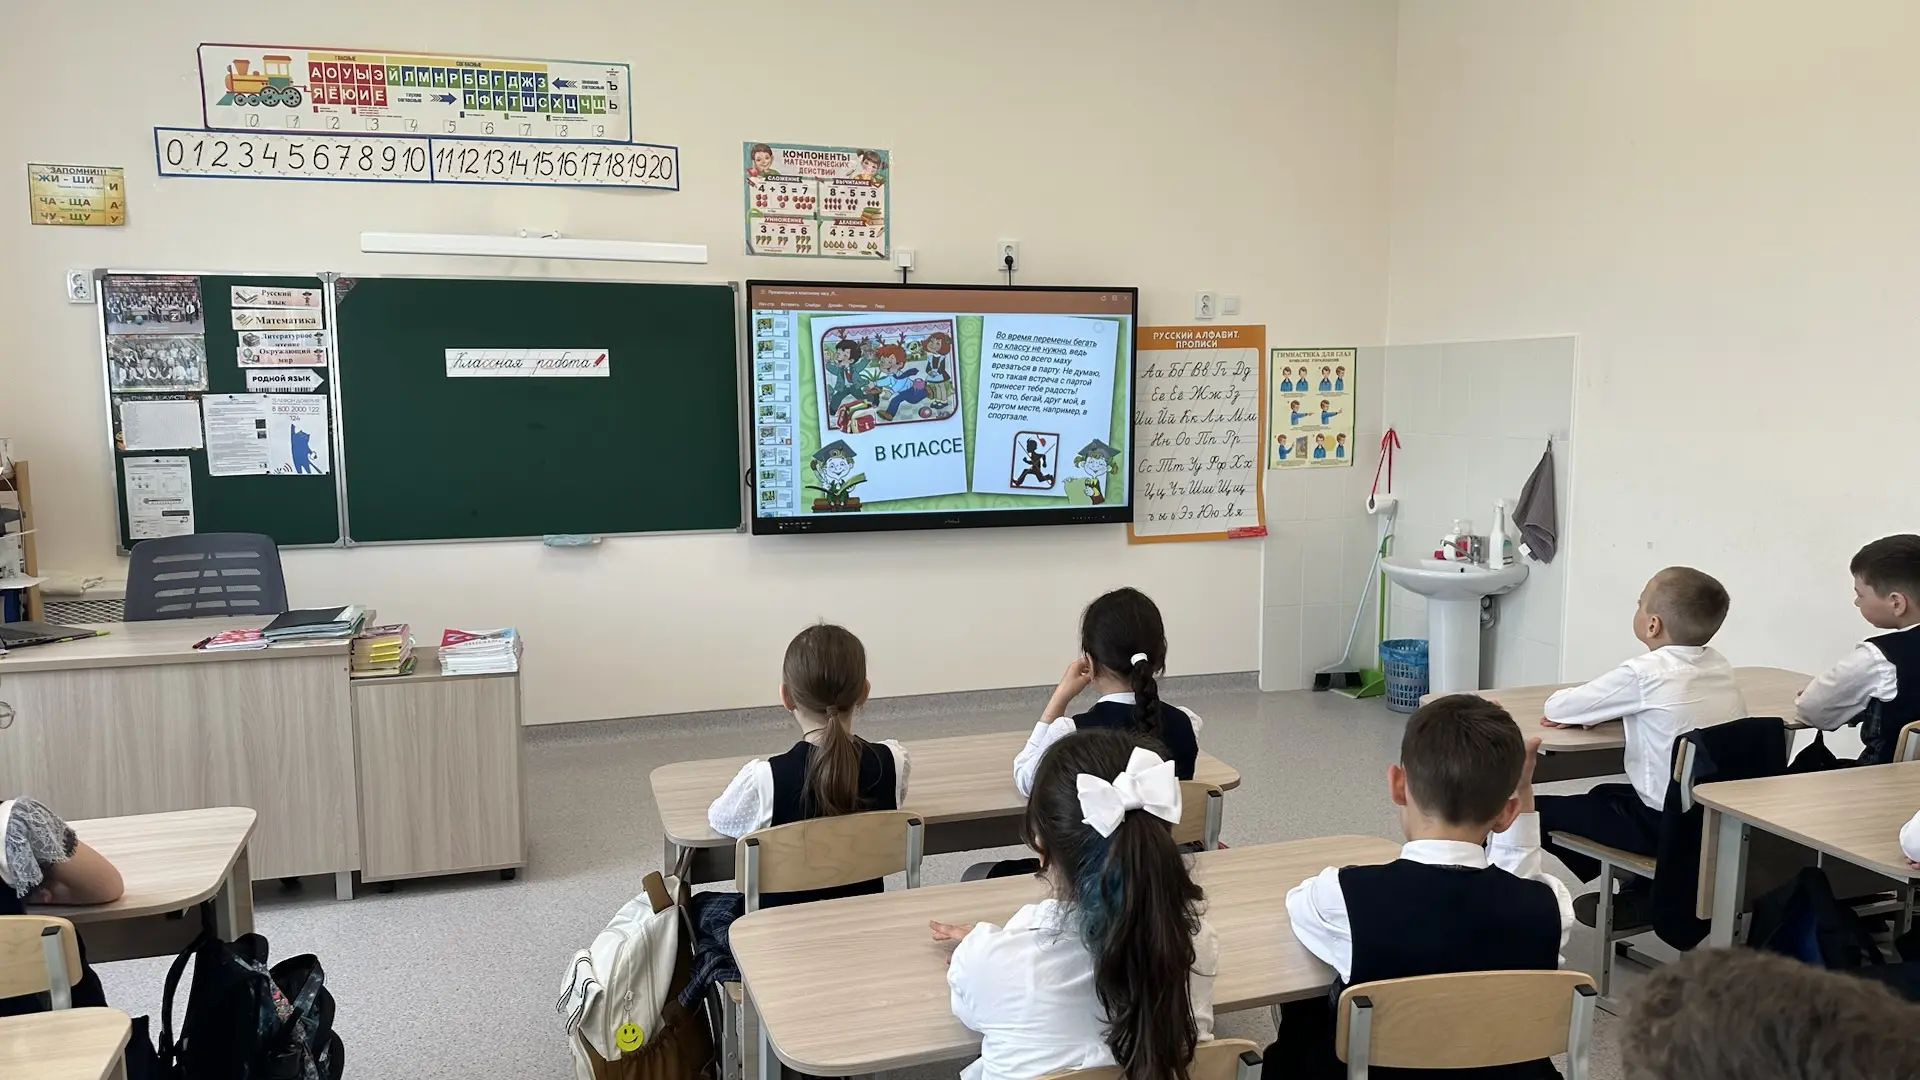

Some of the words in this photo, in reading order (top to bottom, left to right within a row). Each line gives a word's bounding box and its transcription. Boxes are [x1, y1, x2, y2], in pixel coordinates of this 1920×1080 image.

[167, 139, 183, 165] 0
[194, 140, 203, 166] 1
[212, 141, 228, 167] 2
[238, 142, 253, 168] 3
[262, 143, 277, 168] 4
[288, 144, 304, 169] 5
[313, 144, 329, 170] 6
[336, 145, 351, 170] 7
[358, 146, 373, 171] 8
[381, 146, 396, 172] 9
[402, 147, 426, 172] 10
[782, 150, 850, 161] КОМПОНЕНТЫ
[436, 148, 453, 173] 11
[458, 149, 479, 173] 12
[484, 149, 504, 174] 13
[508, 150, 528, 175] 14
[533, 151, 553, 176] 15
[557, 152, 578, 176] 16
[581, 152, 602, 176] 17
[605, 153, 624, 177] 18
[628, 153, 647, 178] 19
[649, 155, 672, 180] 20
[784, 159, 849, 168] МАТЕМАТИЧЕСКИХ
[798, 167, 836, 176] ДЕЙСТВИЙ
[73, 176, 94, 184] ШИ
[780, 186, 787, 194] 3
[830, 188, 836, 196] 8
[871, 190, 877, 198] 3
[40, 197, 56, 205] ЧА
[69, 199, 91, 207] ЩА
[41, 212, 57, 220] ЧУ
[70, 214, 91, 222] ЩУ
[110, 216, 119, 224] У
[760, 225, 767, 233] 3
[779, 226, 786, 234] 2
[801, 227, 808, 235] 6
[830, 228, 836, 236] 4
[849, 229, 854, 237] 2
[869, 230, 875, 238] 2
[256, 316, 316, 324] Математика
[996, 331, 1006, 339] Во
[1008, 333, 1032, 341] время
[1033, 336, 1072, 345] перемены
[1073, 338, 1097, 347] бегать
[1153, 330, 1193, 339] РУССКИЙ
[1195, 330, 1240, 339] АЛФАВИТ.
[1176, 340, 1218, 348] ПРОПИСИ
[1004, 344, 1031, 352] классу
[1043, 347, 1067, 355] нужно,
[452, 351, 523, 369] Классная
[532, 352, 591, 375] работа
[1054, 358, 1072, 366] маху
[992, 363, 1031, 371] врезаться
[1038, 367, 1060, 376] парту.
[1062, 367, 1073, 375] Не
[1073, 369, 1100, 377] думаю,
[1141, 364, 1164, 378] Аа
[1168, 362, 1192, 377] Бб
[1191, 362, 1211, 377] Вв
[1212, 361, 1227, 376] Гг
[1233, 361, 1251, 381] Дд
[1029, 376, 1058, 384] встреча
[990, 382, 1025, 391] принесет
[990, 391, 1002, 399] Так
[1021, 394, 1042, 403] бегай,
[1044, 397, 1062, 405] друг
[1152, 387, 1166, 401] Ее
[1189, 385, 1221, 400] Жж
[1226, 385, 1240, 405] Зз
[988, 402, 1016, 410] другом
[1043, 407, 1080, 416] например,
[987, 412, 1028, 421] спортзале.
[1157, 407, 1176, 424] Йй
[1180, 409, 1198, 423] Кк
[1201, 409, 1224, 422] Лл
[1228, 408, 1257, 421] Мм
[1151, 433, 1171, 446] Нн
[1176, 432, 1190, 445] Оо
[1195, 431, 1217, 445] Пп
[1223, 430, 1240, 448] Рр
[875, 446, 886, 461] В
[891, 438, 963, 459] КЛАССЕ
[1138, 459, 1152, 473] Сс
[1156, 458, 1184, 472] Тт
[1189, 457, 1202, 476] Уу
[1207, 456, 1226, 475] Фф
[1230, 455, 1252, 469] Хх
[1144, 483, 1165, 500] Цц
[1169, 482, 1185, 495] Чч
[1189, 480, 1215, 494] Шш
[1218, 480, 1245, 496] Щщ
[1179, 506, 1193, 519] Ээ
[1197, 504, 1219, 518] Юю
[1223, 503, 1243, 517] Яя
